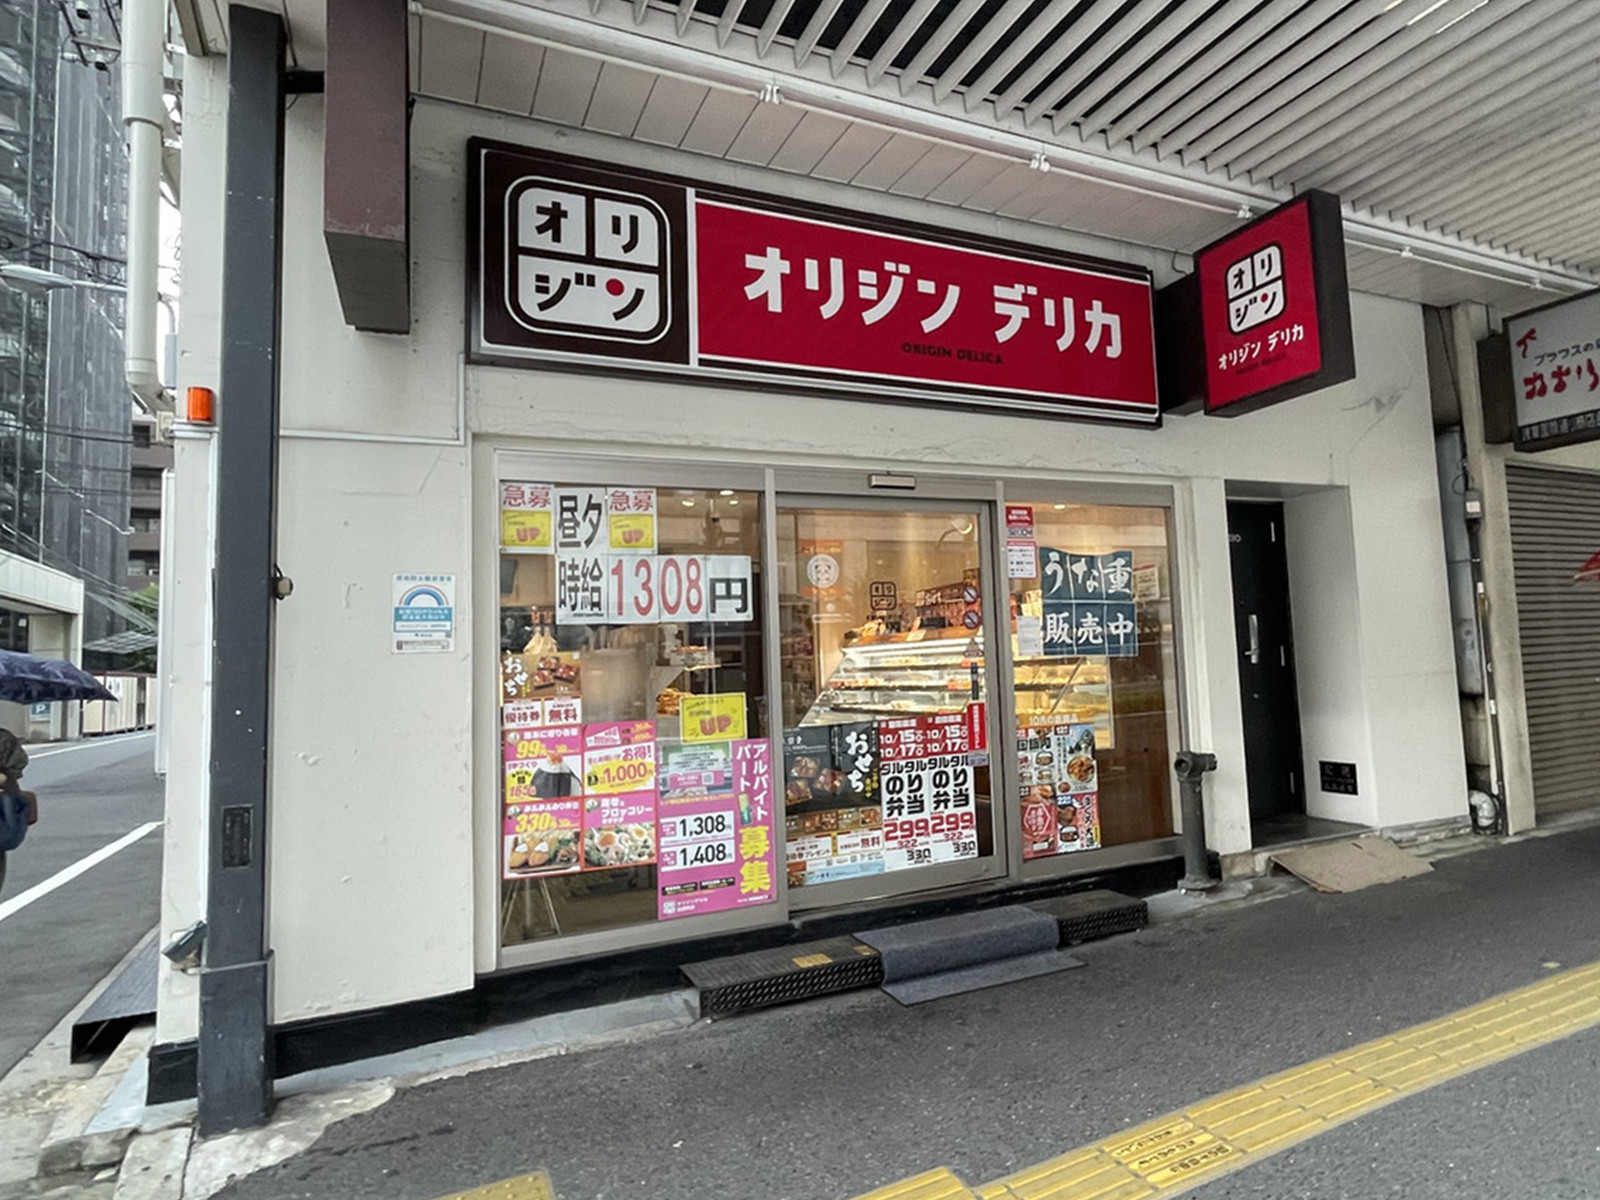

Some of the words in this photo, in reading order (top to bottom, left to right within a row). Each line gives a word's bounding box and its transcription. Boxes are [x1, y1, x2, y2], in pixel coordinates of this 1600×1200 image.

[535, 201, 639, 254] オリ
[1233, 253, 1272, 290] オリ
[744, 246, 960, 334] オリジン
[993, 283, 1122, 359] デリカ
[902, 342, 952, 359] ORIGIN
[956, 348, 1004, 365] DELICA
[1218, 341, 1261, 371] オリジン
[1268, 324, 1304, 352] デリカ
[503, 484, 551, 508] 急募
[609, 489, 654, 512] 急募
[1044, 551, 1132, 595] うな重
[1044, 611, 1134, 646] 販売中
[504, 657, 528, 696] おせち
[700, 714, 732, 736] UP
[736, 744, 751, 792] パート
[845, 731, 873, 793] おせち
[881, 760, 927, 776] タルタル
[932, 768, 968, 790] のり
[752, 743, 768, 821] アルバイト
[885, 774, 923, 795] のり
[932, 787, 969, 811] 弁当
[886, 793, 925, 817] 弁当
[739, 825, 771, 895] 募集
